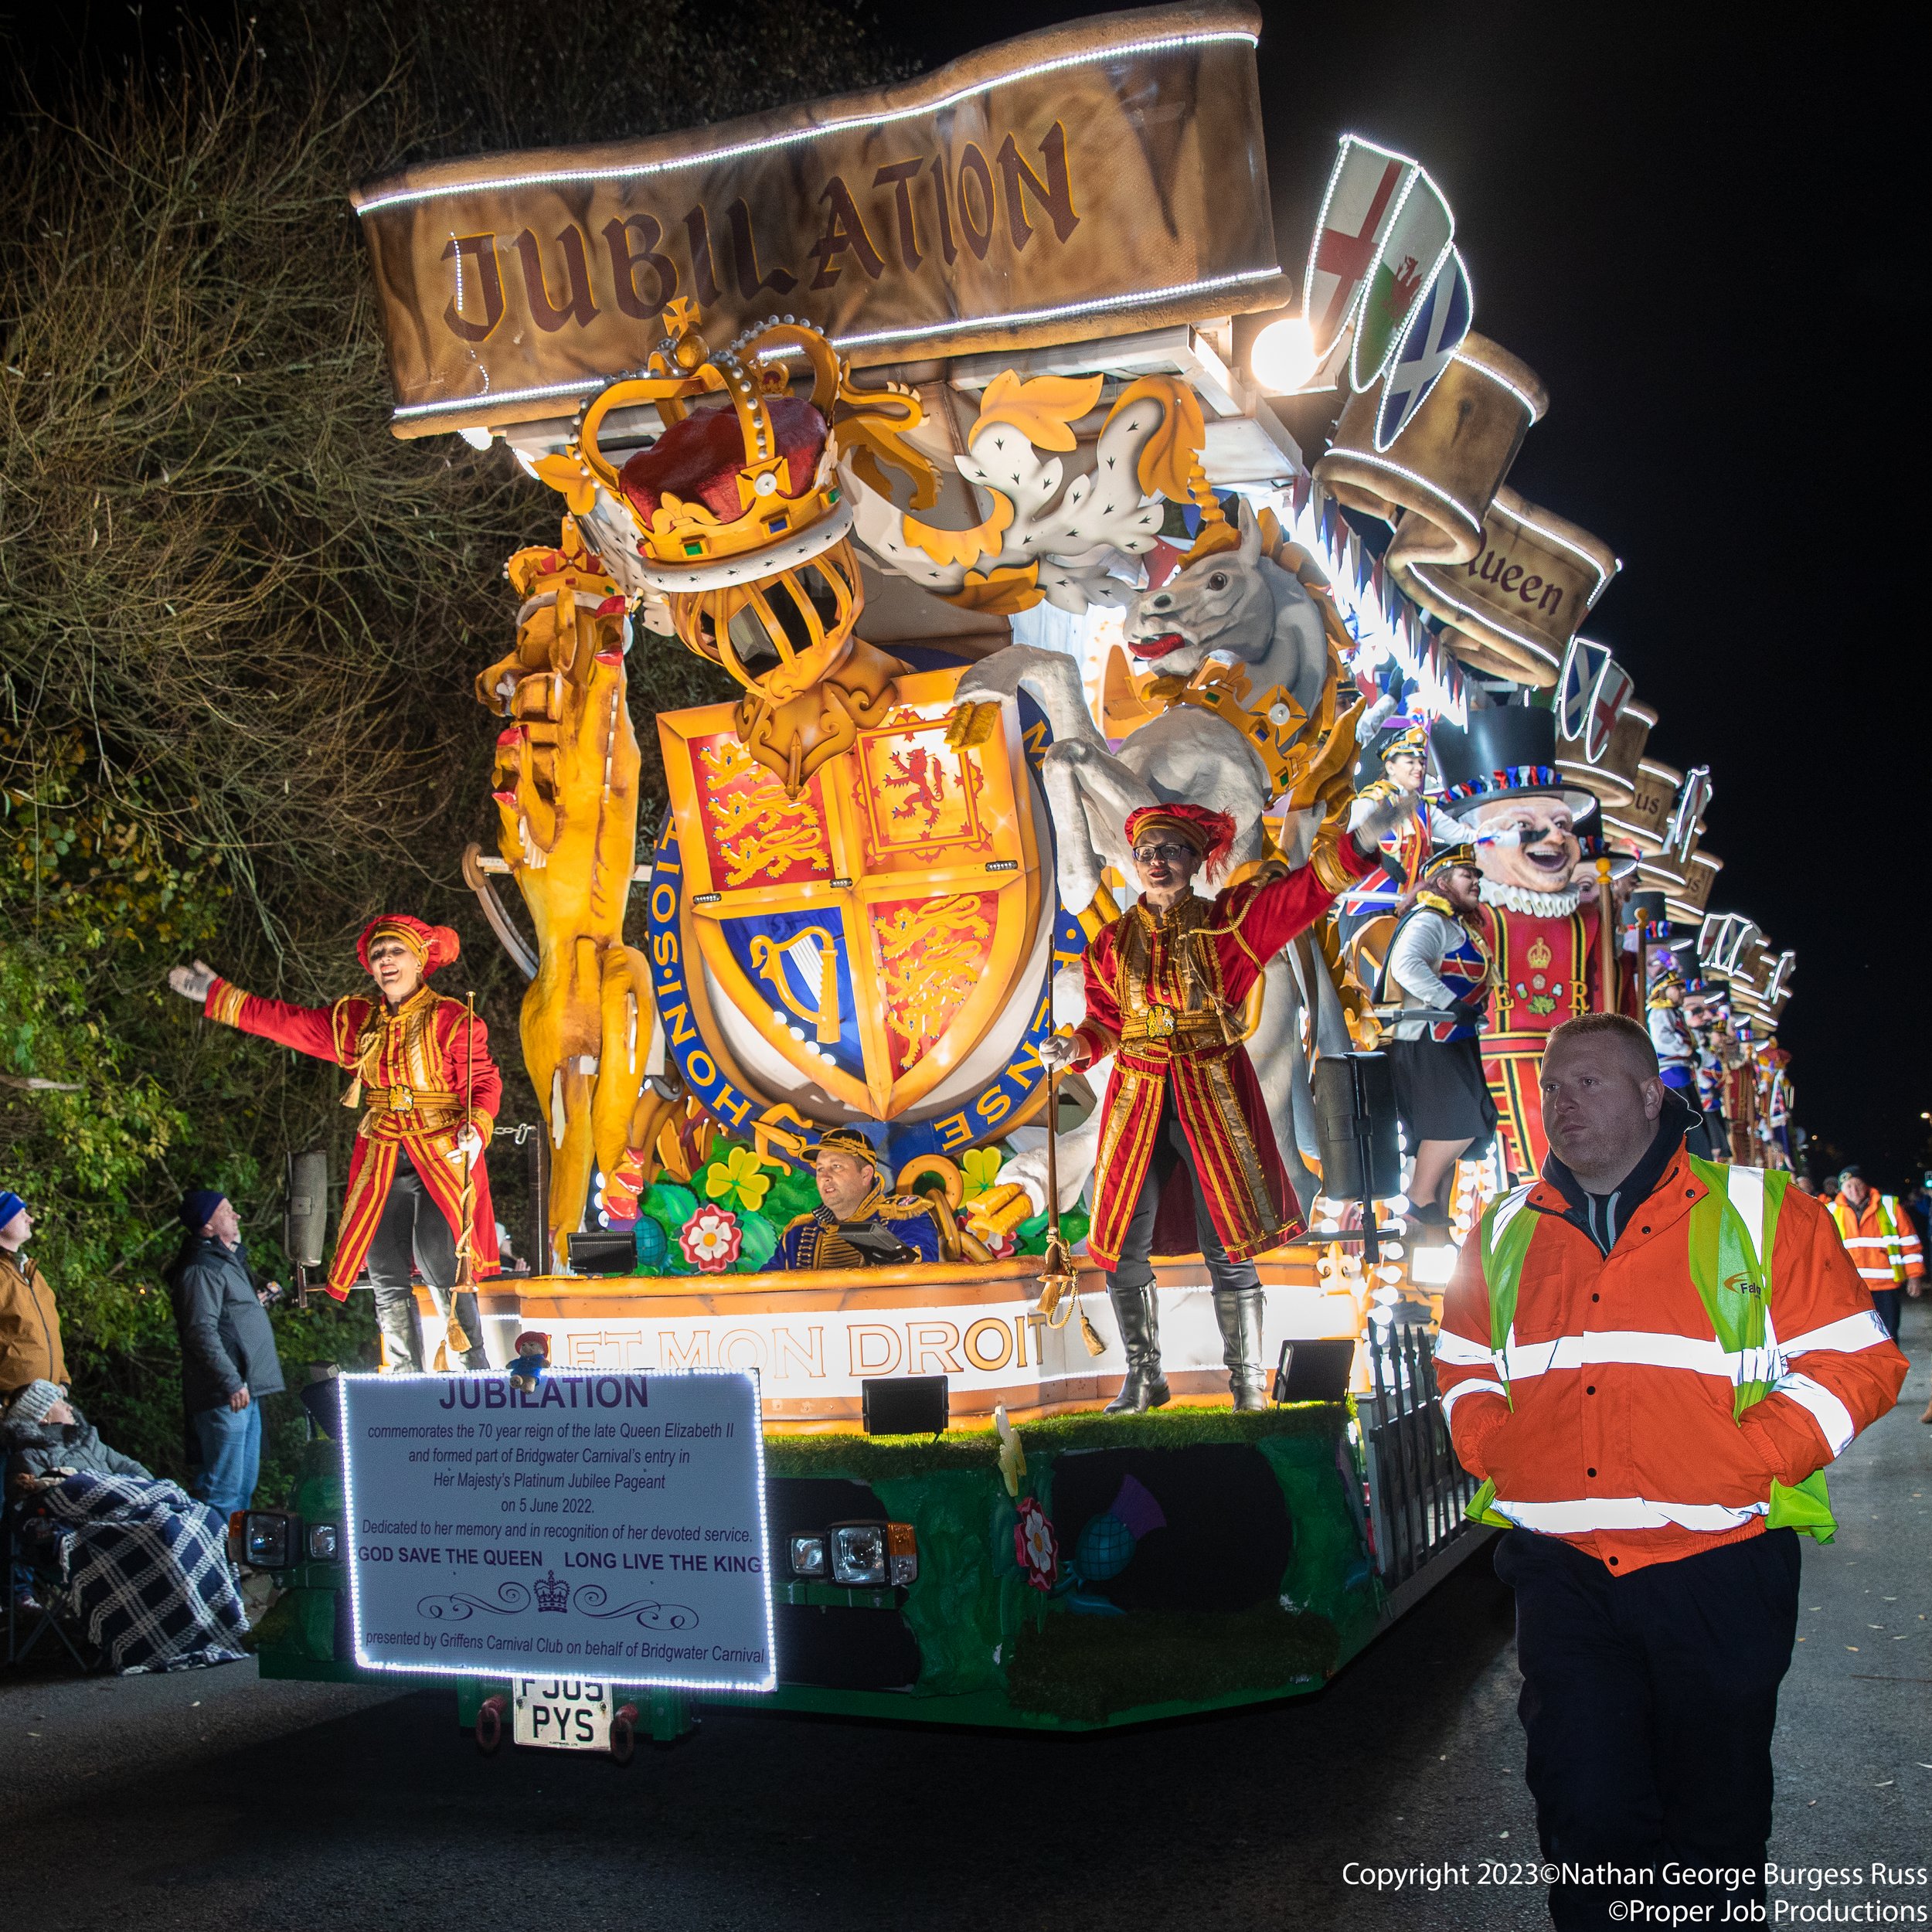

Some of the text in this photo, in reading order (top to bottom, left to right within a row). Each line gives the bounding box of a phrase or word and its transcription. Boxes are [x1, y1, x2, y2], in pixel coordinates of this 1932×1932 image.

[440, 118, 1081, 343] JUBILATION
[1493, 979, 1590, 1012] E R
[566, 1331, 643, 1368] ET
[658, 1326, 827, 1379] MON
[847, 1313, 1047, 1377] DROIT
[439, 1376, 648, 1410] JUBILATION
[368, 1423, 734, 1441] commemorates the 70 year reign of the late Queen Elizabeth II
[409, 1447, 690, 1467] and formed part of Bridgwater Carnival's entry in
[434, 1472, 665, 1492] Her Majesty's Platinum Jubilee Pageant
[501, 1498, 594, 1513] on 5 June 2022.
[362, 1519, 753, 1543] Dedicated to her memory and in recognition of her devoted service.
[359, 1546, 762, 1573] GOD SAVE THE QUEEN LONG LIVE THE KING
[366, 1631, 765, 1663] presented by Griffens Carnival Club on behalf of Bridgwater Carnival
[532, 1705, 594, 1742] PYS
